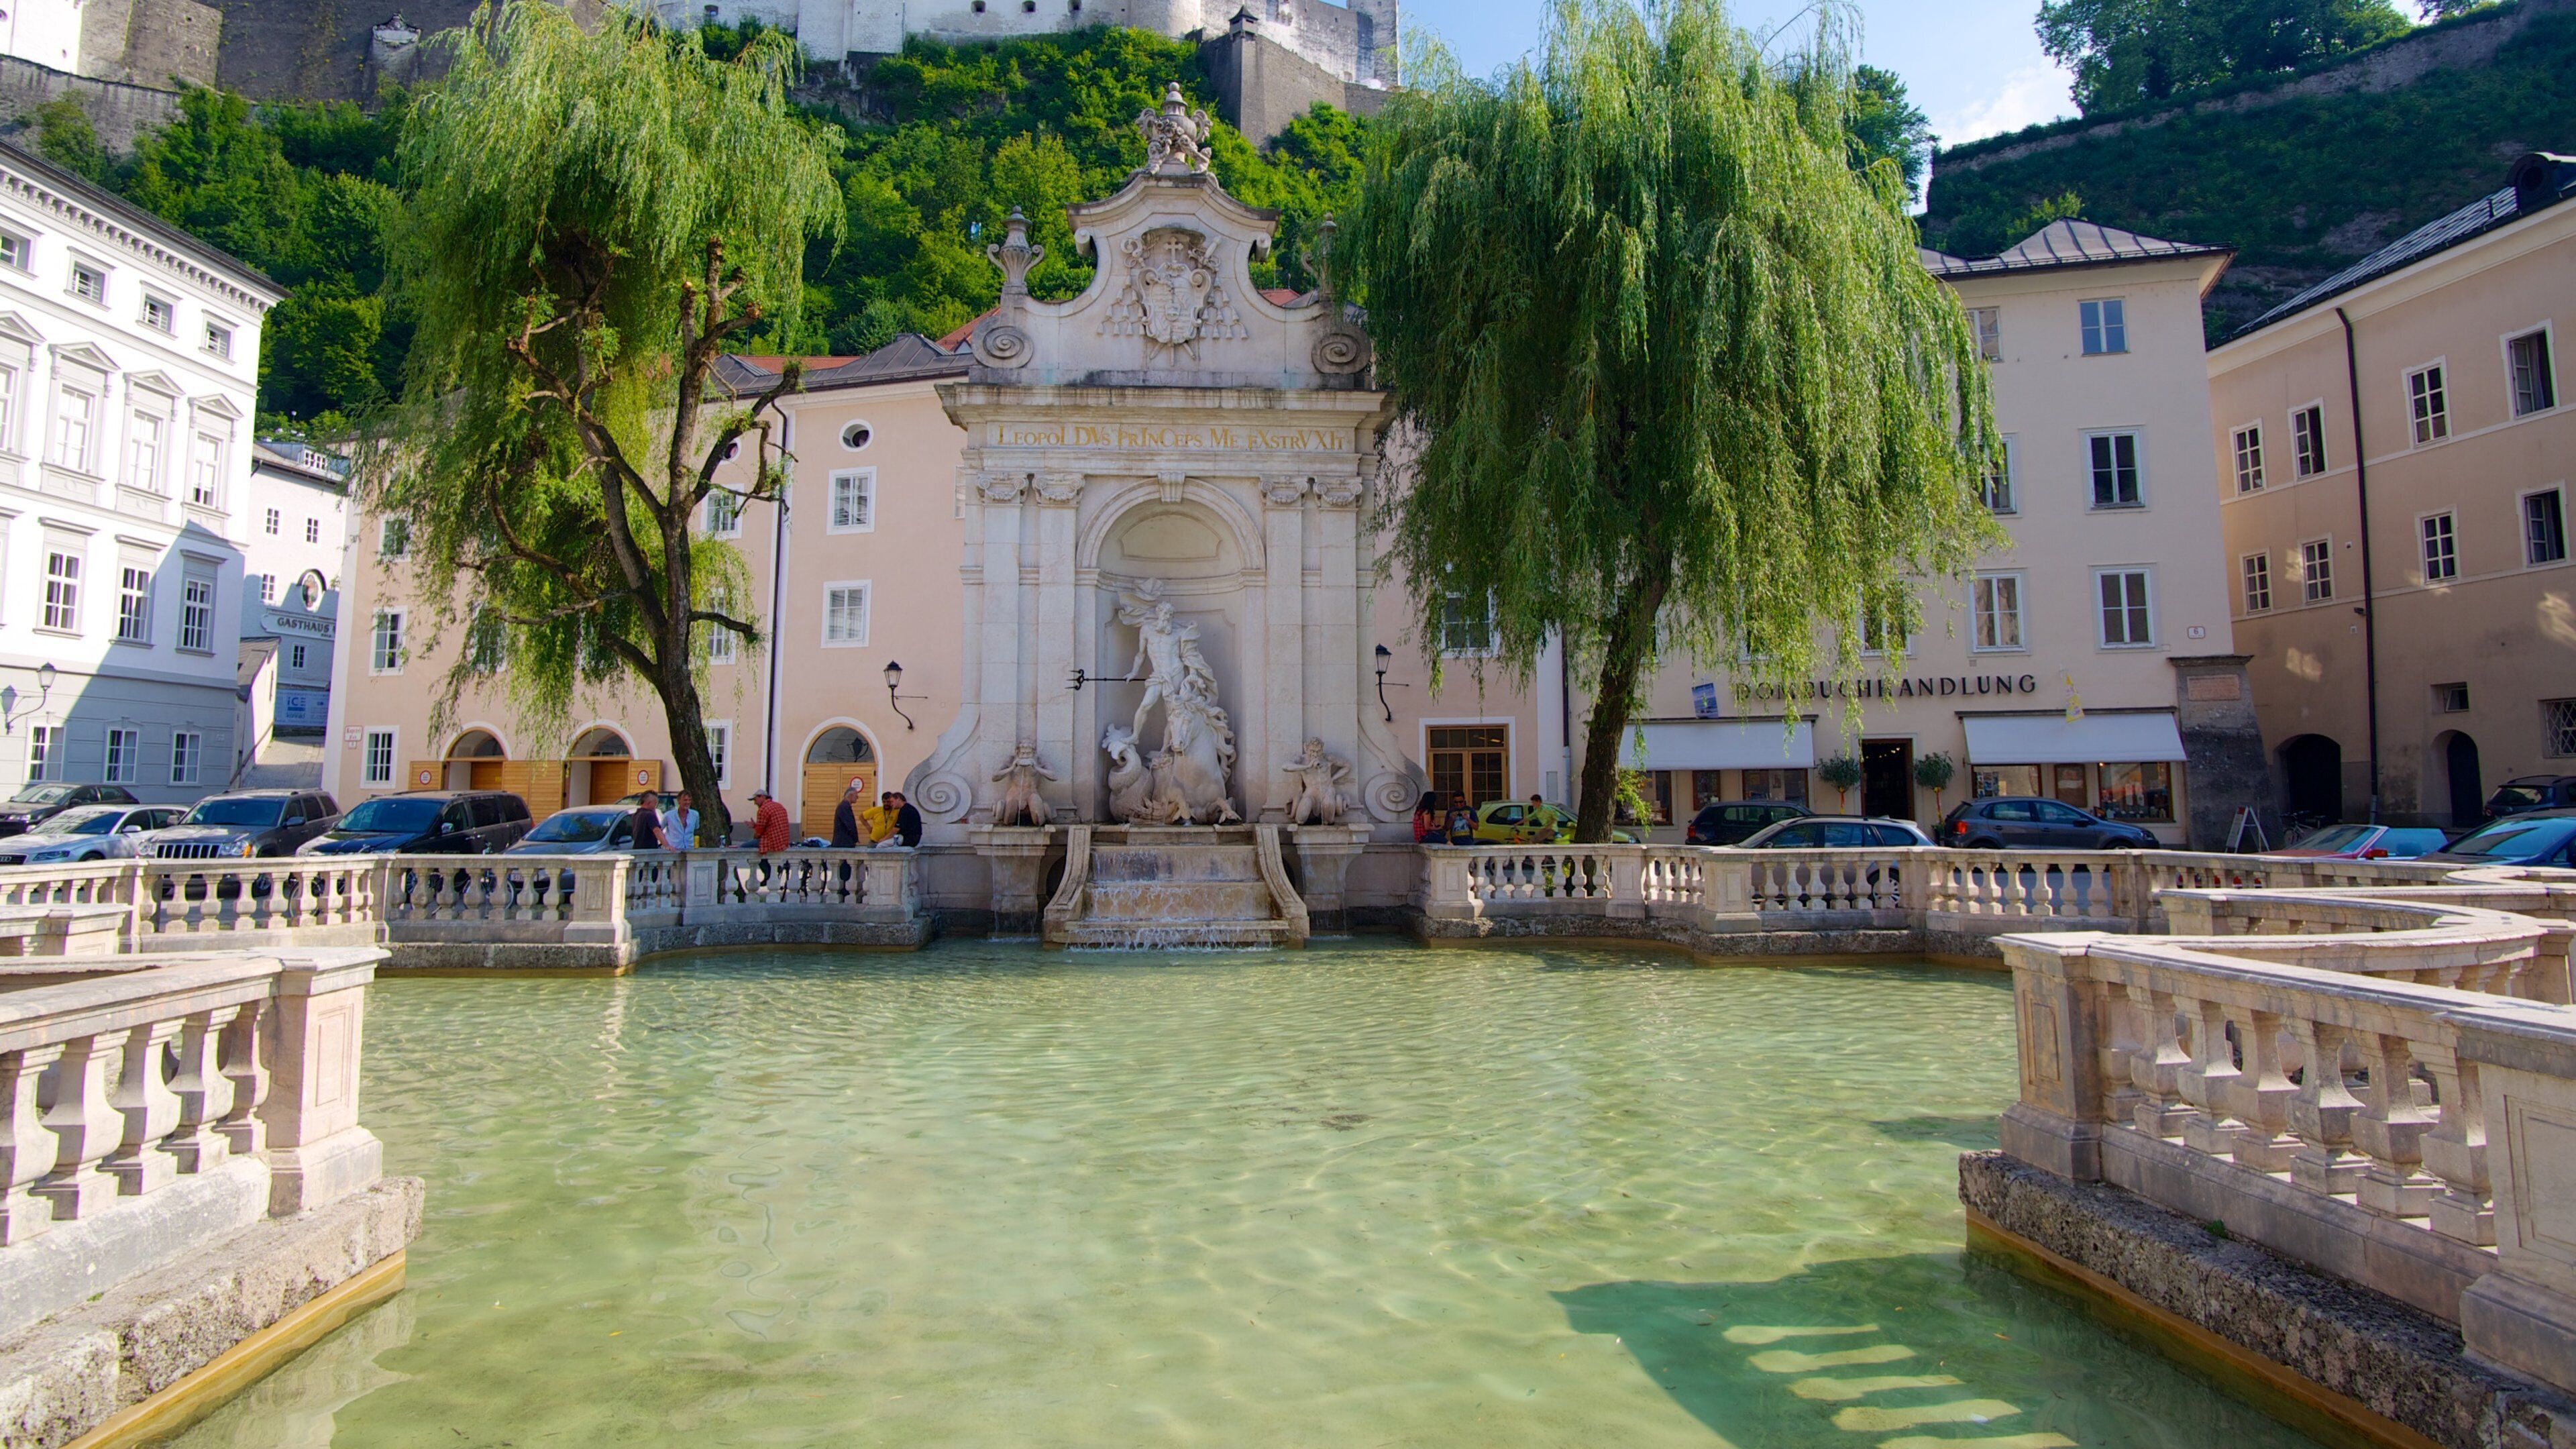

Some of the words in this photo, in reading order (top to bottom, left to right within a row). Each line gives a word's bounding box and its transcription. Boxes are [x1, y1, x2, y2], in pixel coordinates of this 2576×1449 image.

[1118, 427, 1203, 447] PRINCEPS
[1210, 428, 1239, 448] ME
[277, 616, 330, 633] GASTHAUS
